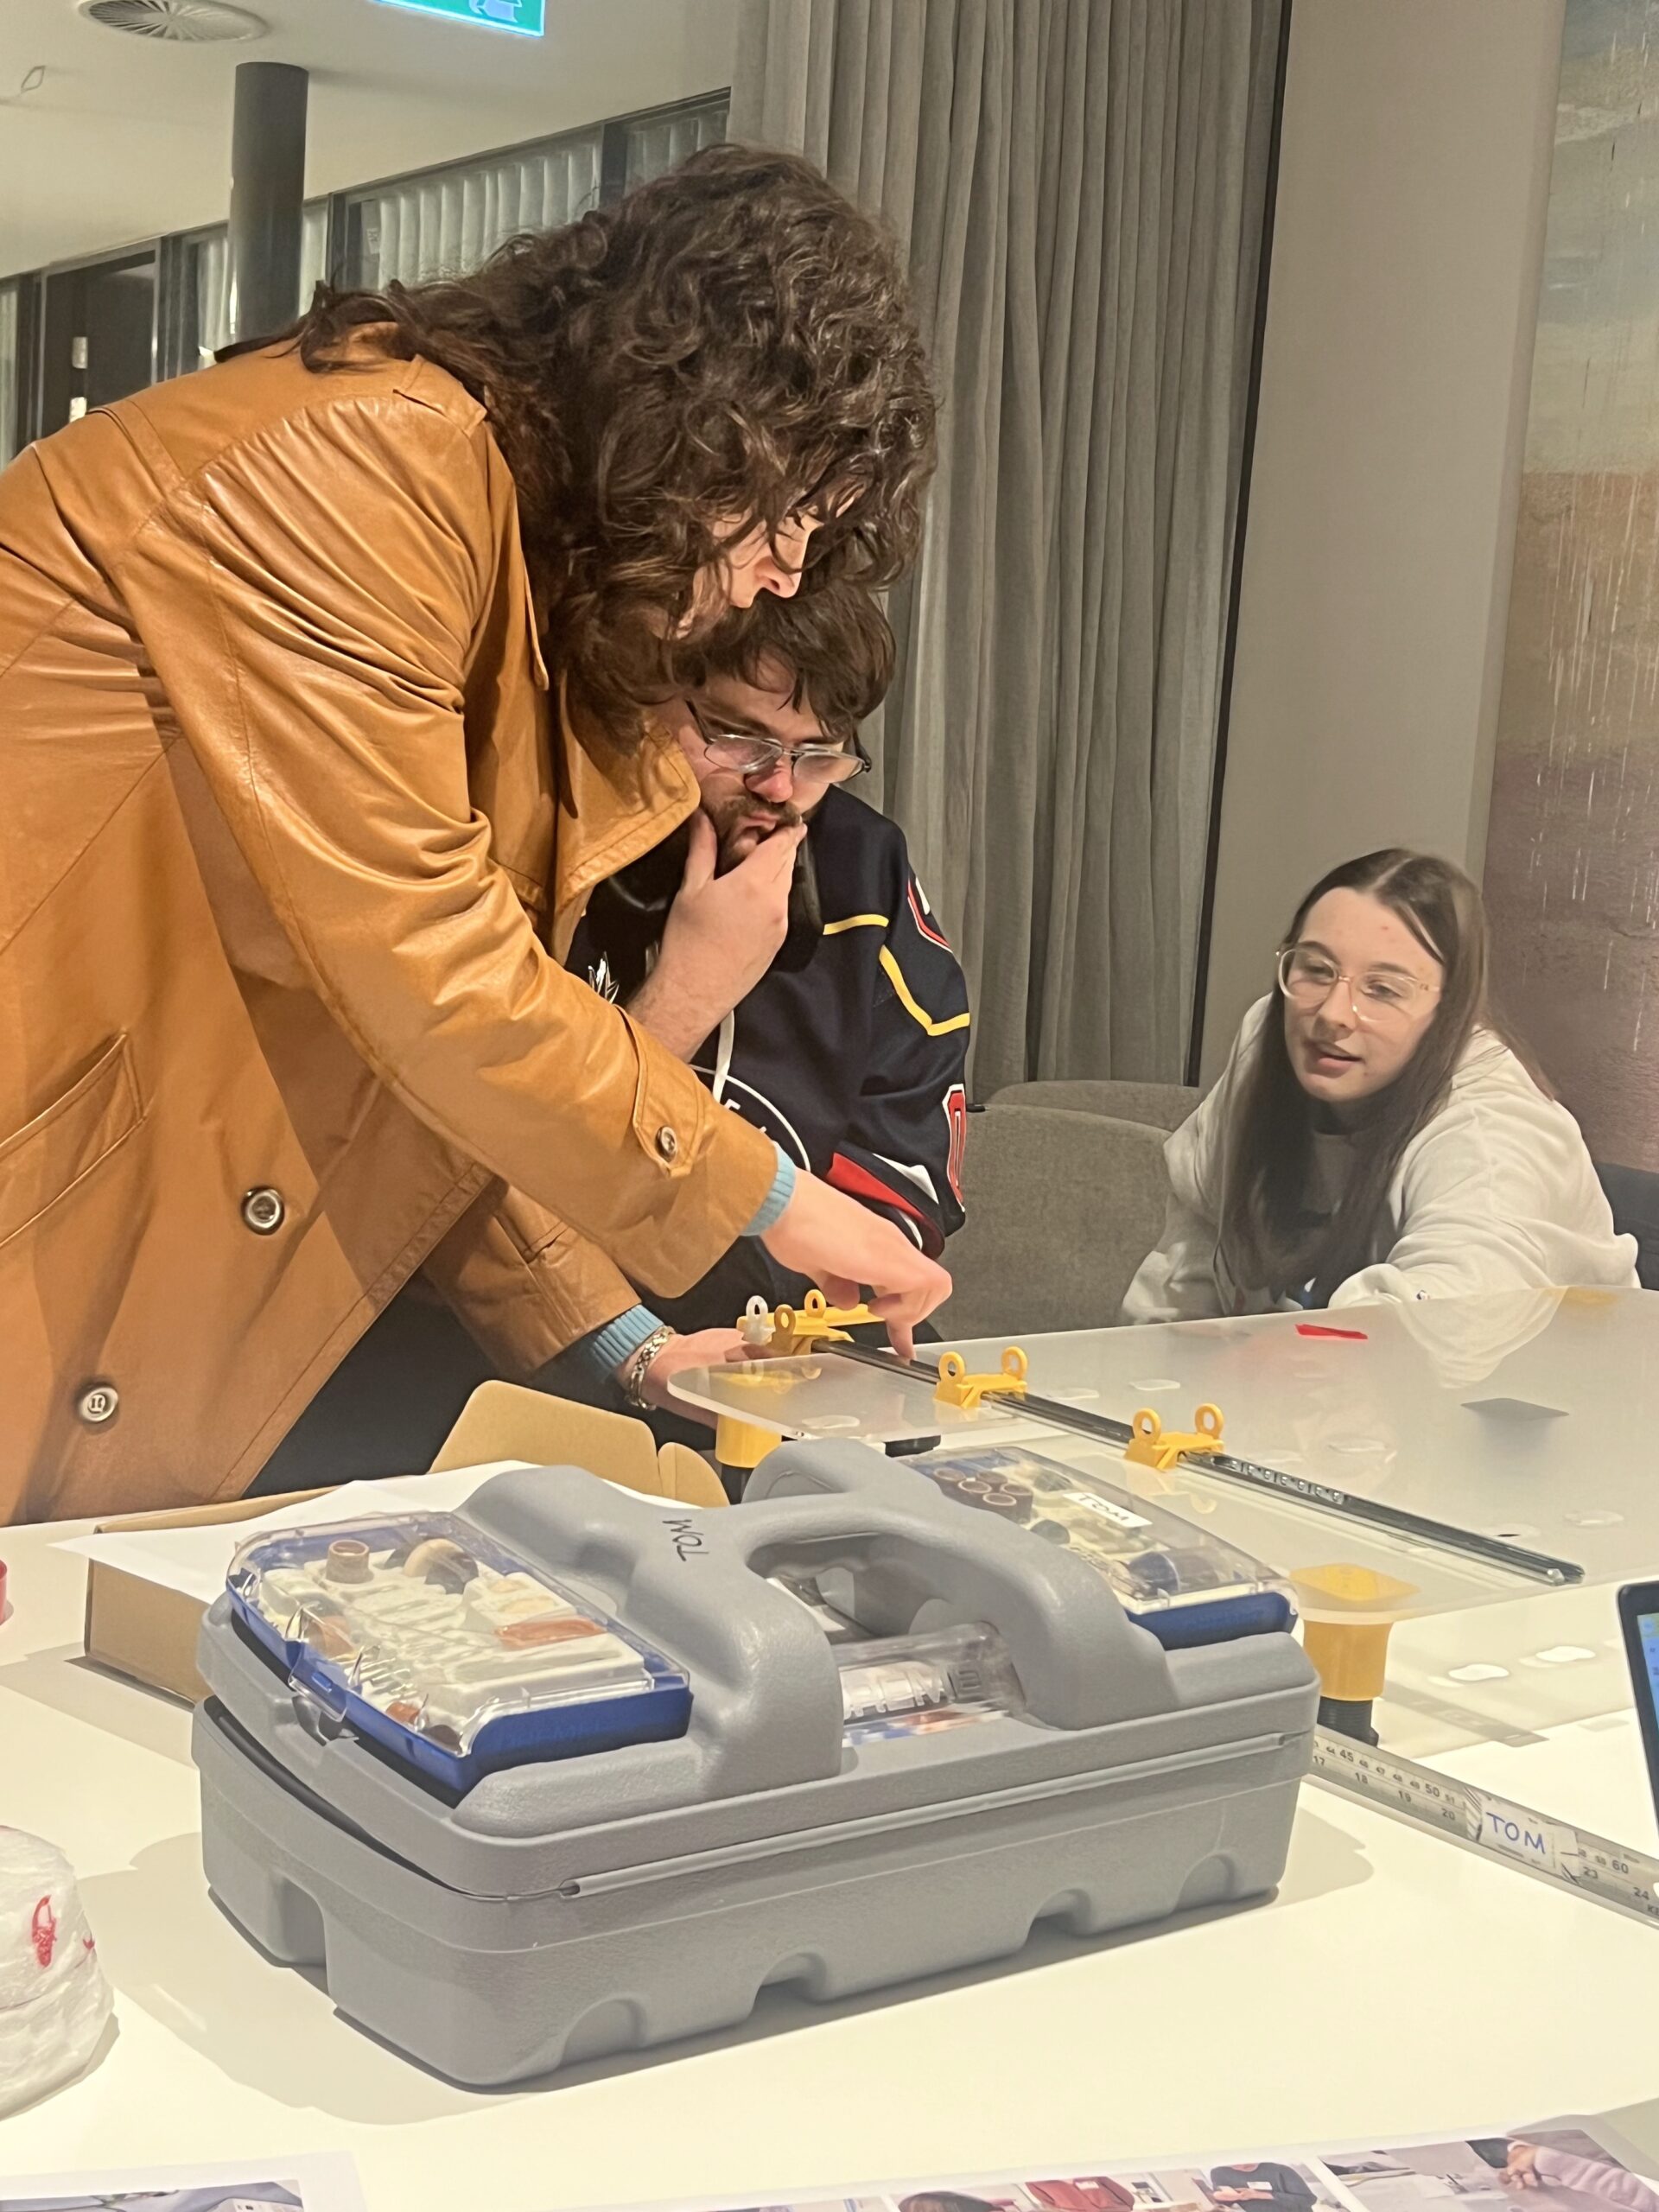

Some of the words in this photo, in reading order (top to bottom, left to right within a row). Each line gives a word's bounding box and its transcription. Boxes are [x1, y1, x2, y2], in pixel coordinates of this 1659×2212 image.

[1078, 1493, 1129, 1521] TOM
[662, 1519, 709, 1561] TOM
[1313, 1755, 1325, 1766] 17
[1355, 1772, 1368, 1784] 18
[1441, 1807, 1456, 1821] 20
[1340, 1749, 1354, 1763] 45
[1425, 1783, 1440, 1797] 50
[1485, 1811, 1546, 1854] TOM
[1583, 1866, 1599, 1879] 23
[1633, 1886, 1649, 1900] 24
[1611, 1859, 1629, 1874] 60
